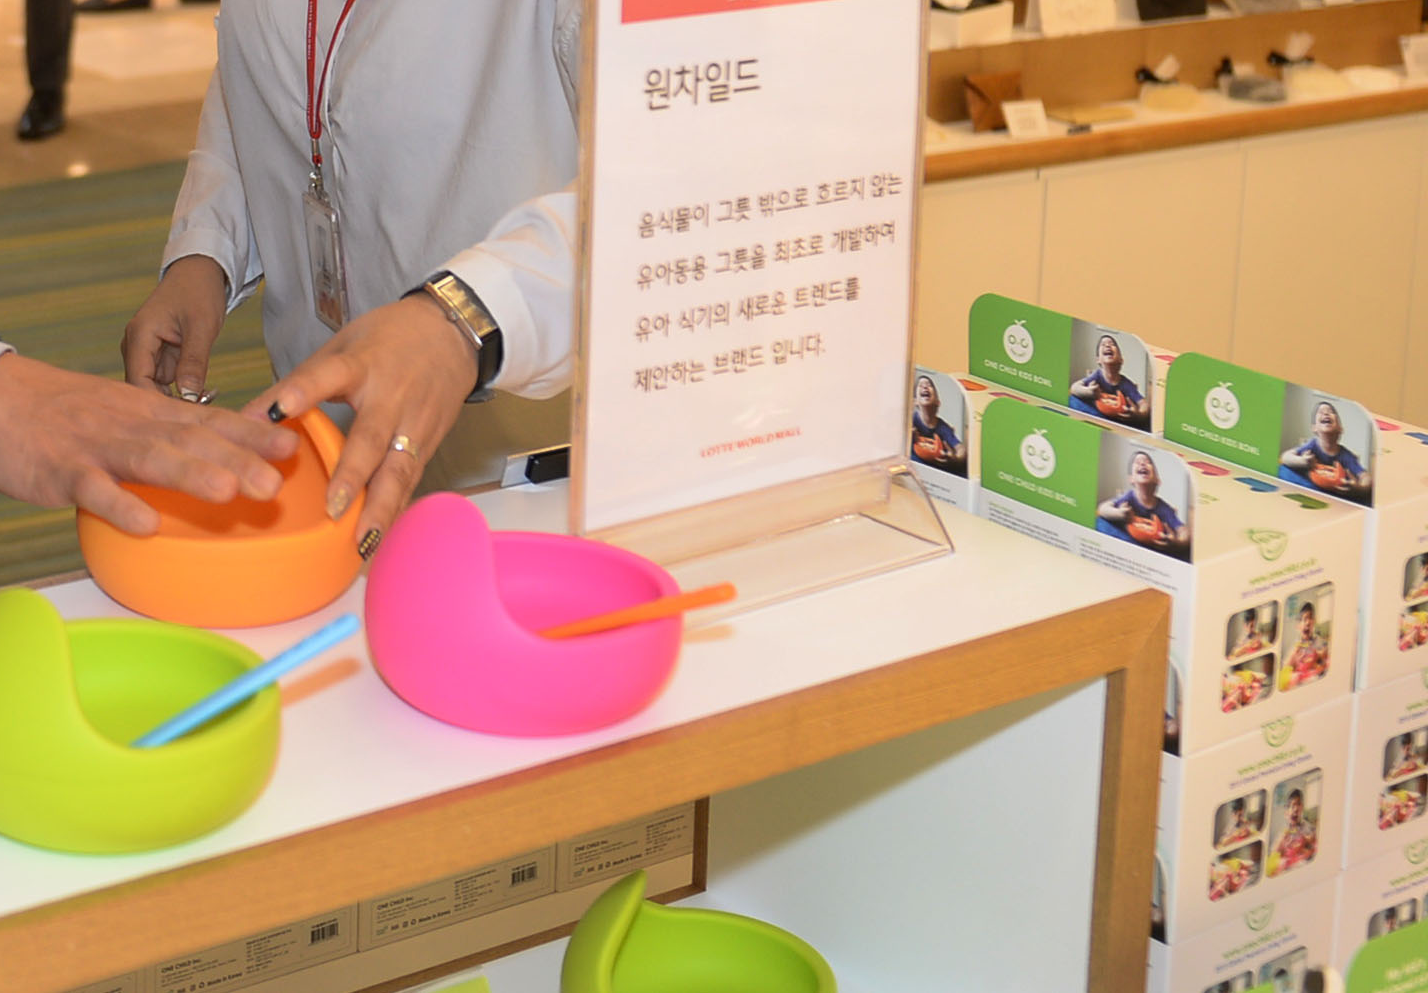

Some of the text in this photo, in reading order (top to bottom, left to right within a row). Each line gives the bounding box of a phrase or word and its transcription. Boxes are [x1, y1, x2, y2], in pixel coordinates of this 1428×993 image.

[643, 59, 761, 111] 원차일드
[639, 173, 903, 239] 음식물이 그릇 밖으로 흐르지 않는
[715, 244, 767, 274] 그릇을
[773, 234, 825, 263] 최초로
[832, 220, 895, 253] 개발하여
[635, 277, 861, 343] 유아 식기의 새로운 트렌드를
[634, 360, 706, 393] 제안하는
[712, 345, 765, 375] 브랜드
[700, 441, 734, 458] LOTTE
[737, 432, 774, 449] WORLD
